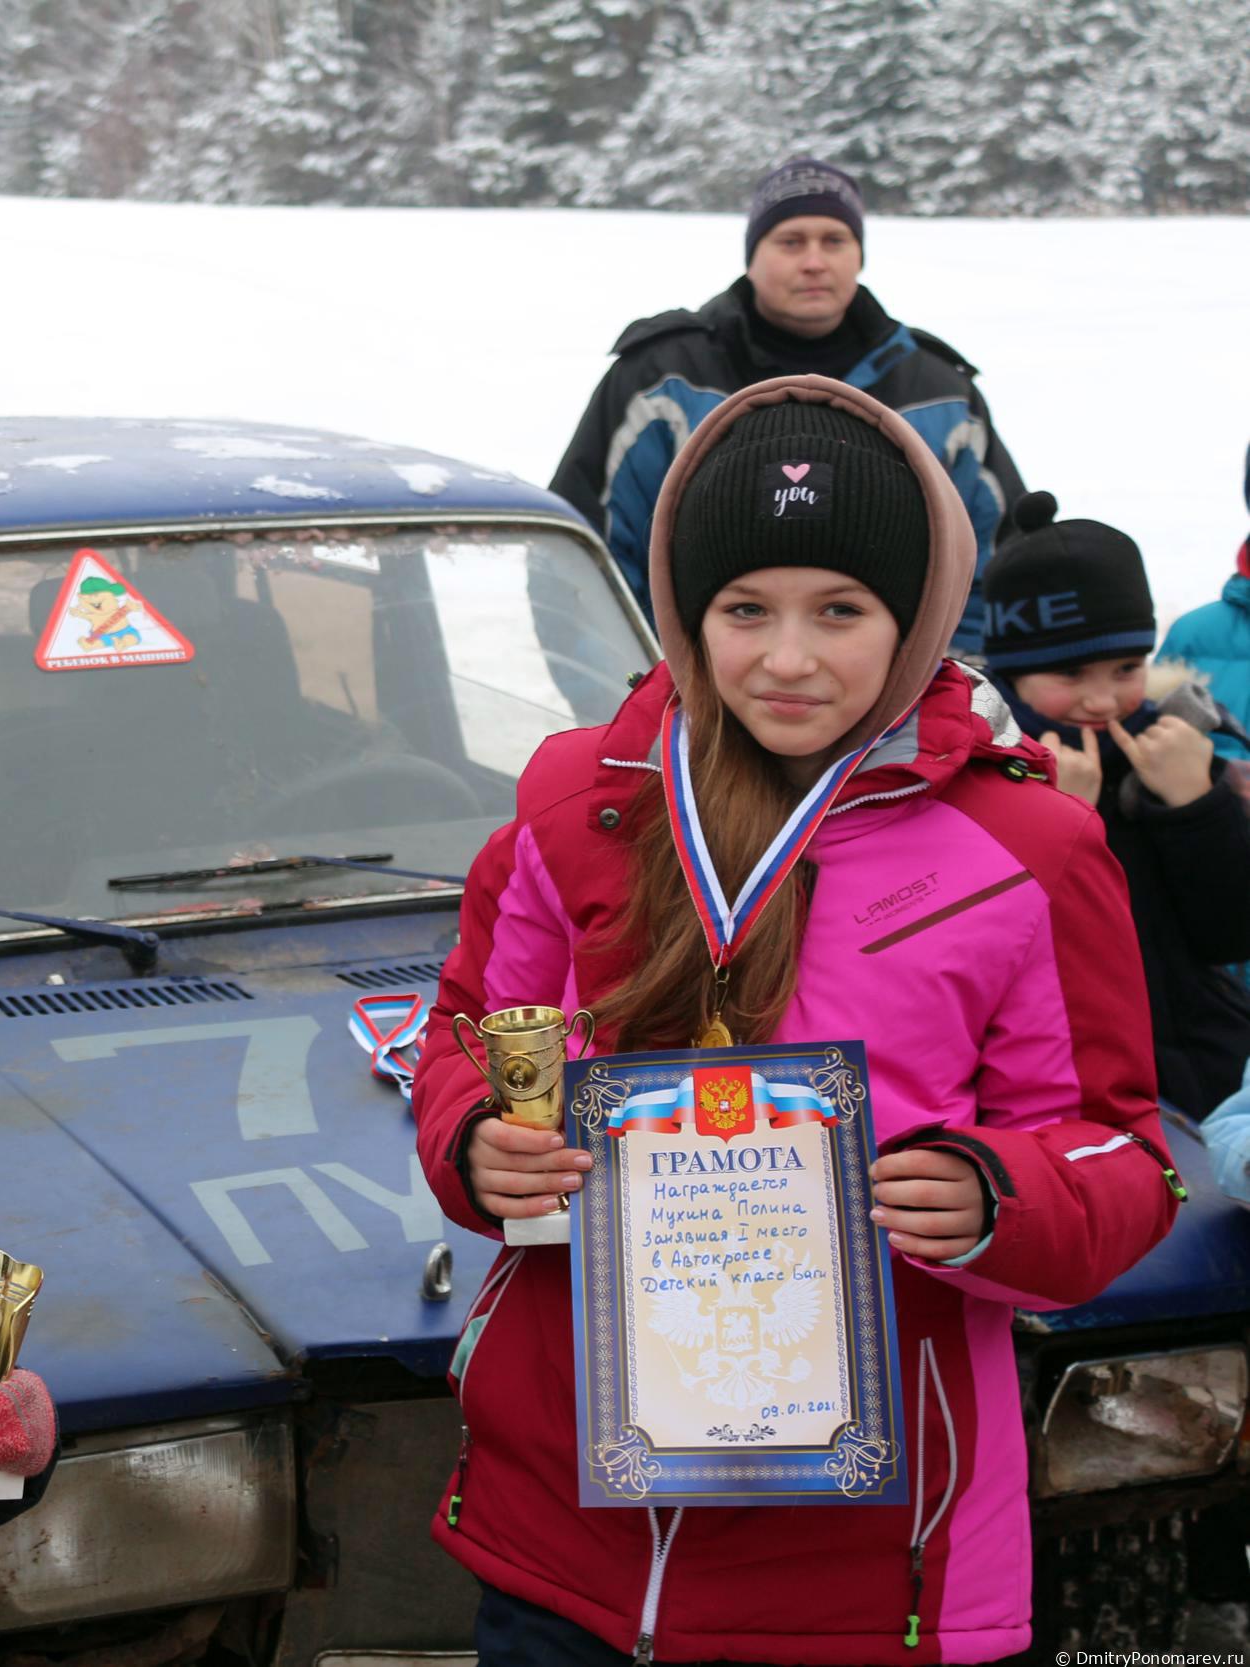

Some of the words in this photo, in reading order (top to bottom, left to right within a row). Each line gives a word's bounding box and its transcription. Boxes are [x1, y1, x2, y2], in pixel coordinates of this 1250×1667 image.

[774, 487, 819, 517] you
[982, 591, 1086, 638] IKE
[47, 657, 109, 668] РЕБЕНОК
[110, 655, 120, 663] В
[853, 871, 938, 925] LAMOST
[51, 1015, 322, 1141] 7
[649, 1146, 806, 1176] ГРАМОТА
[654, 1178, 788, 1201] Награждается
[651, 1207, 723, 1229] Мухина
[737, 1199, 807, 1216] Полина
[756, 1226, 808, 1238] место
[652, 1250, 662, 1268] в
[671, 1248, 773, 1269] Автокроссе
[640, 1273, 718, 1293] Детский
[730, 1270, 786, 1284] класс
